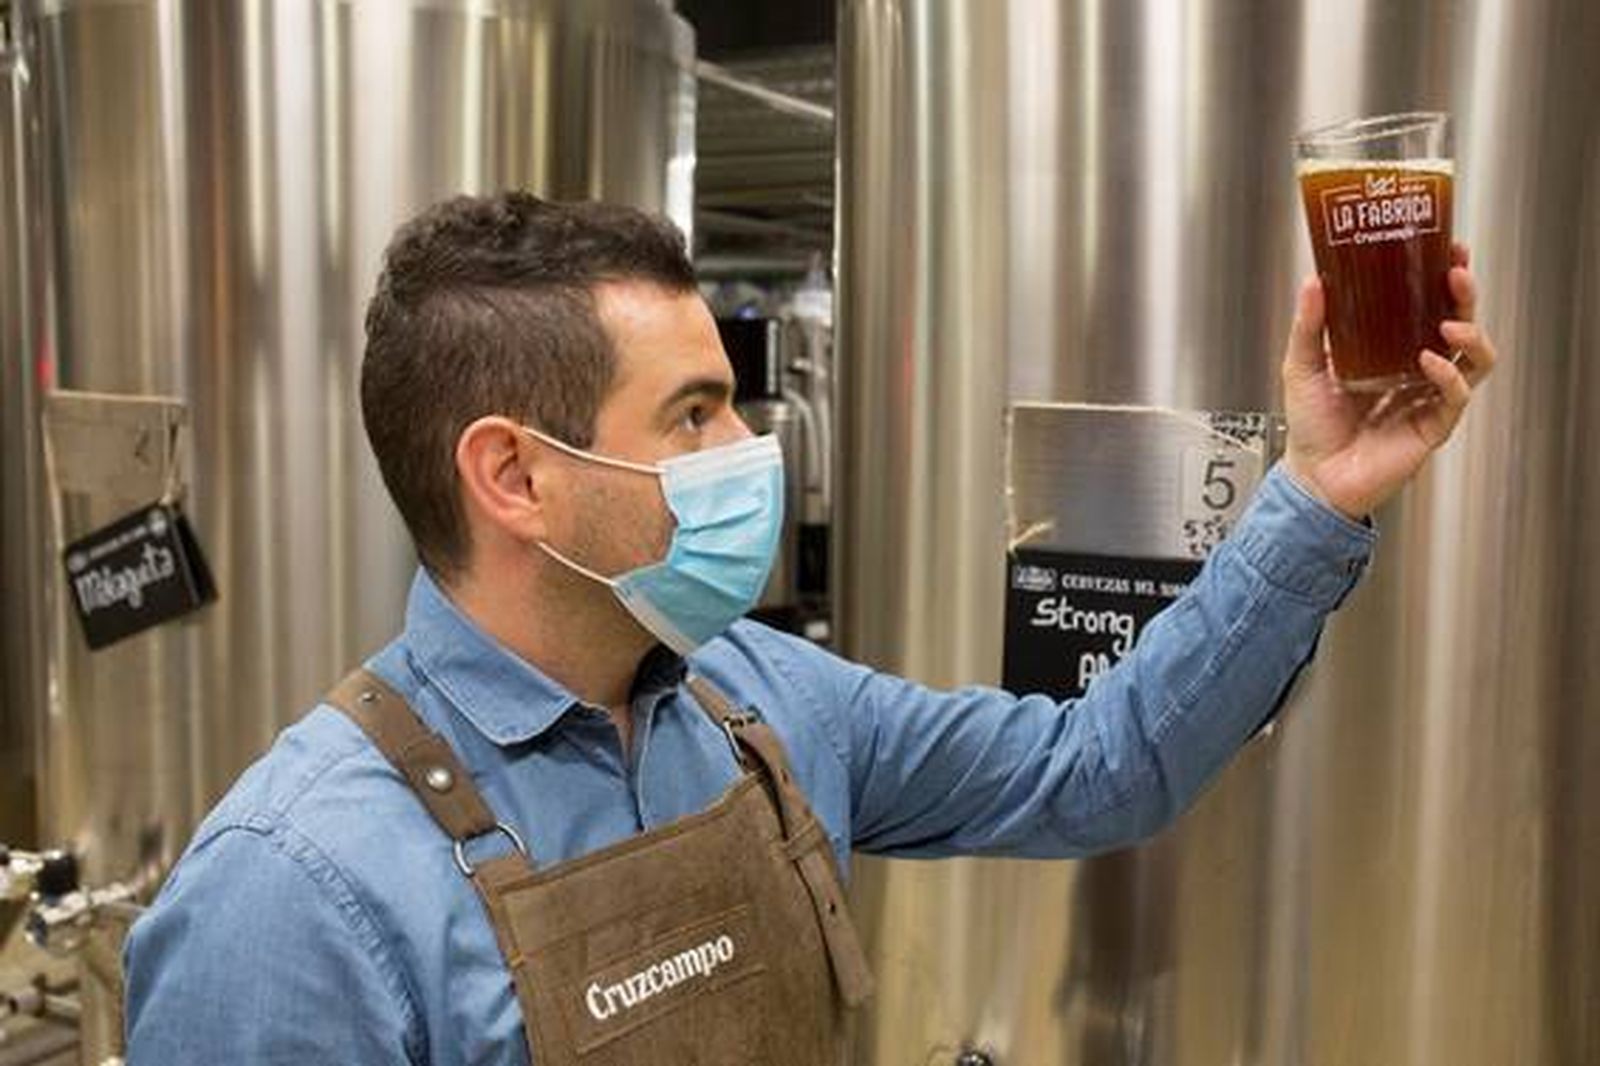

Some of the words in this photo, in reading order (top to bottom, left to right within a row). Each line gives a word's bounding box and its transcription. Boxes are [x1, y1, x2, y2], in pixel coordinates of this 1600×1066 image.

[1333, 202, 1354, 232] LA
[1202, 460, 1236, 511] 5
[1062, 574, 1130, 593] CERVEZAS
[1031, 596, 1134, 656] Strong
[585, 935, 735, 1020] Cruzcampo
